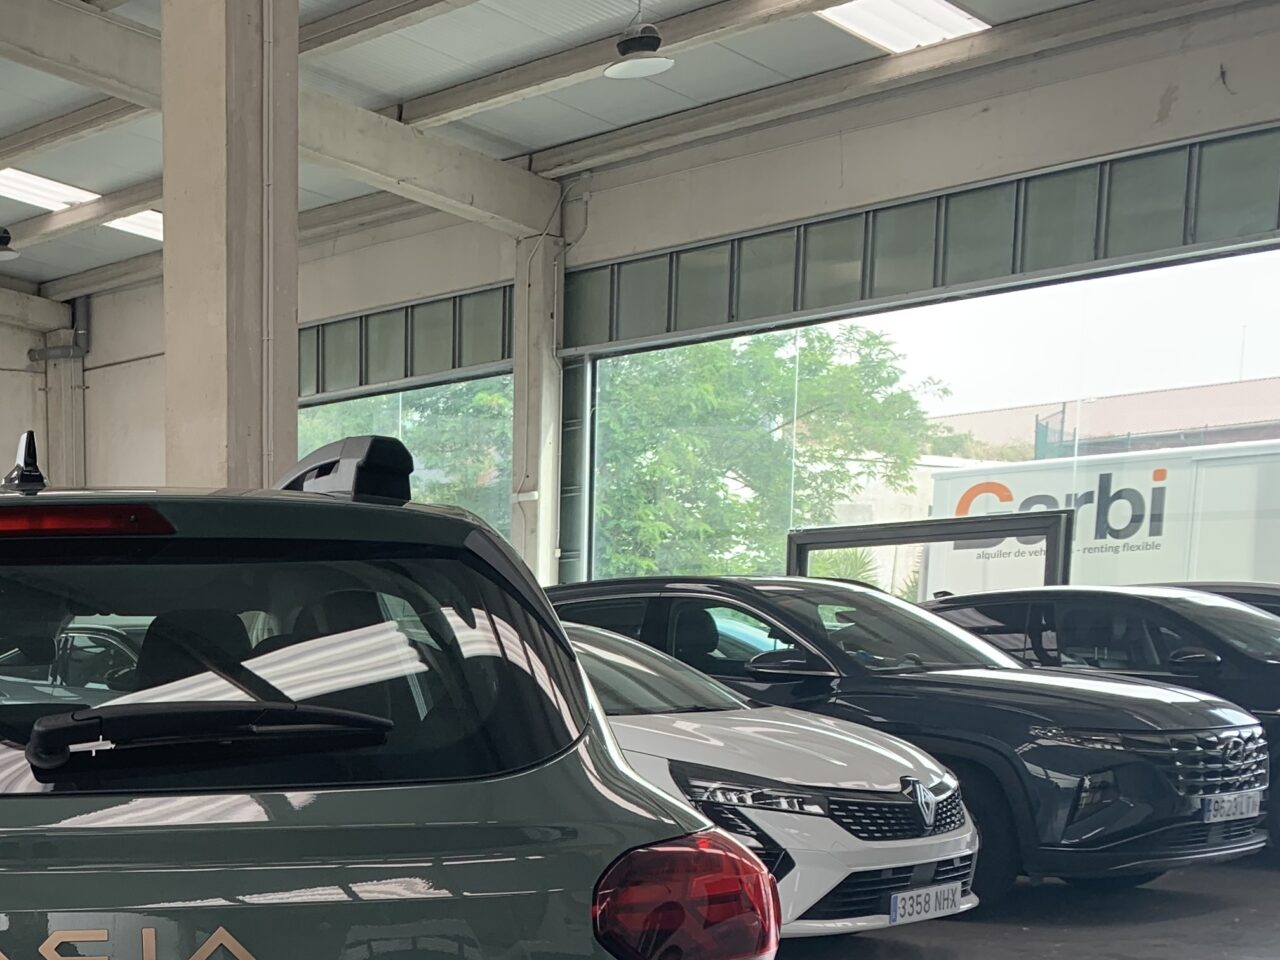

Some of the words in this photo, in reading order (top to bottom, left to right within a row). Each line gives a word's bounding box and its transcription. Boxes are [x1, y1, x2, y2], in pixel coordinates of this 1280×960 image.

[976, 549, 1012, 560] alquiler
[1014, 548, 1027, 558] de
[1082, 543, 1120, 554] renting
[1122, 541, 1162, 552] flexible
[899, 892, 931, 918] 3358
[934, 887, 958, 912] NHX
